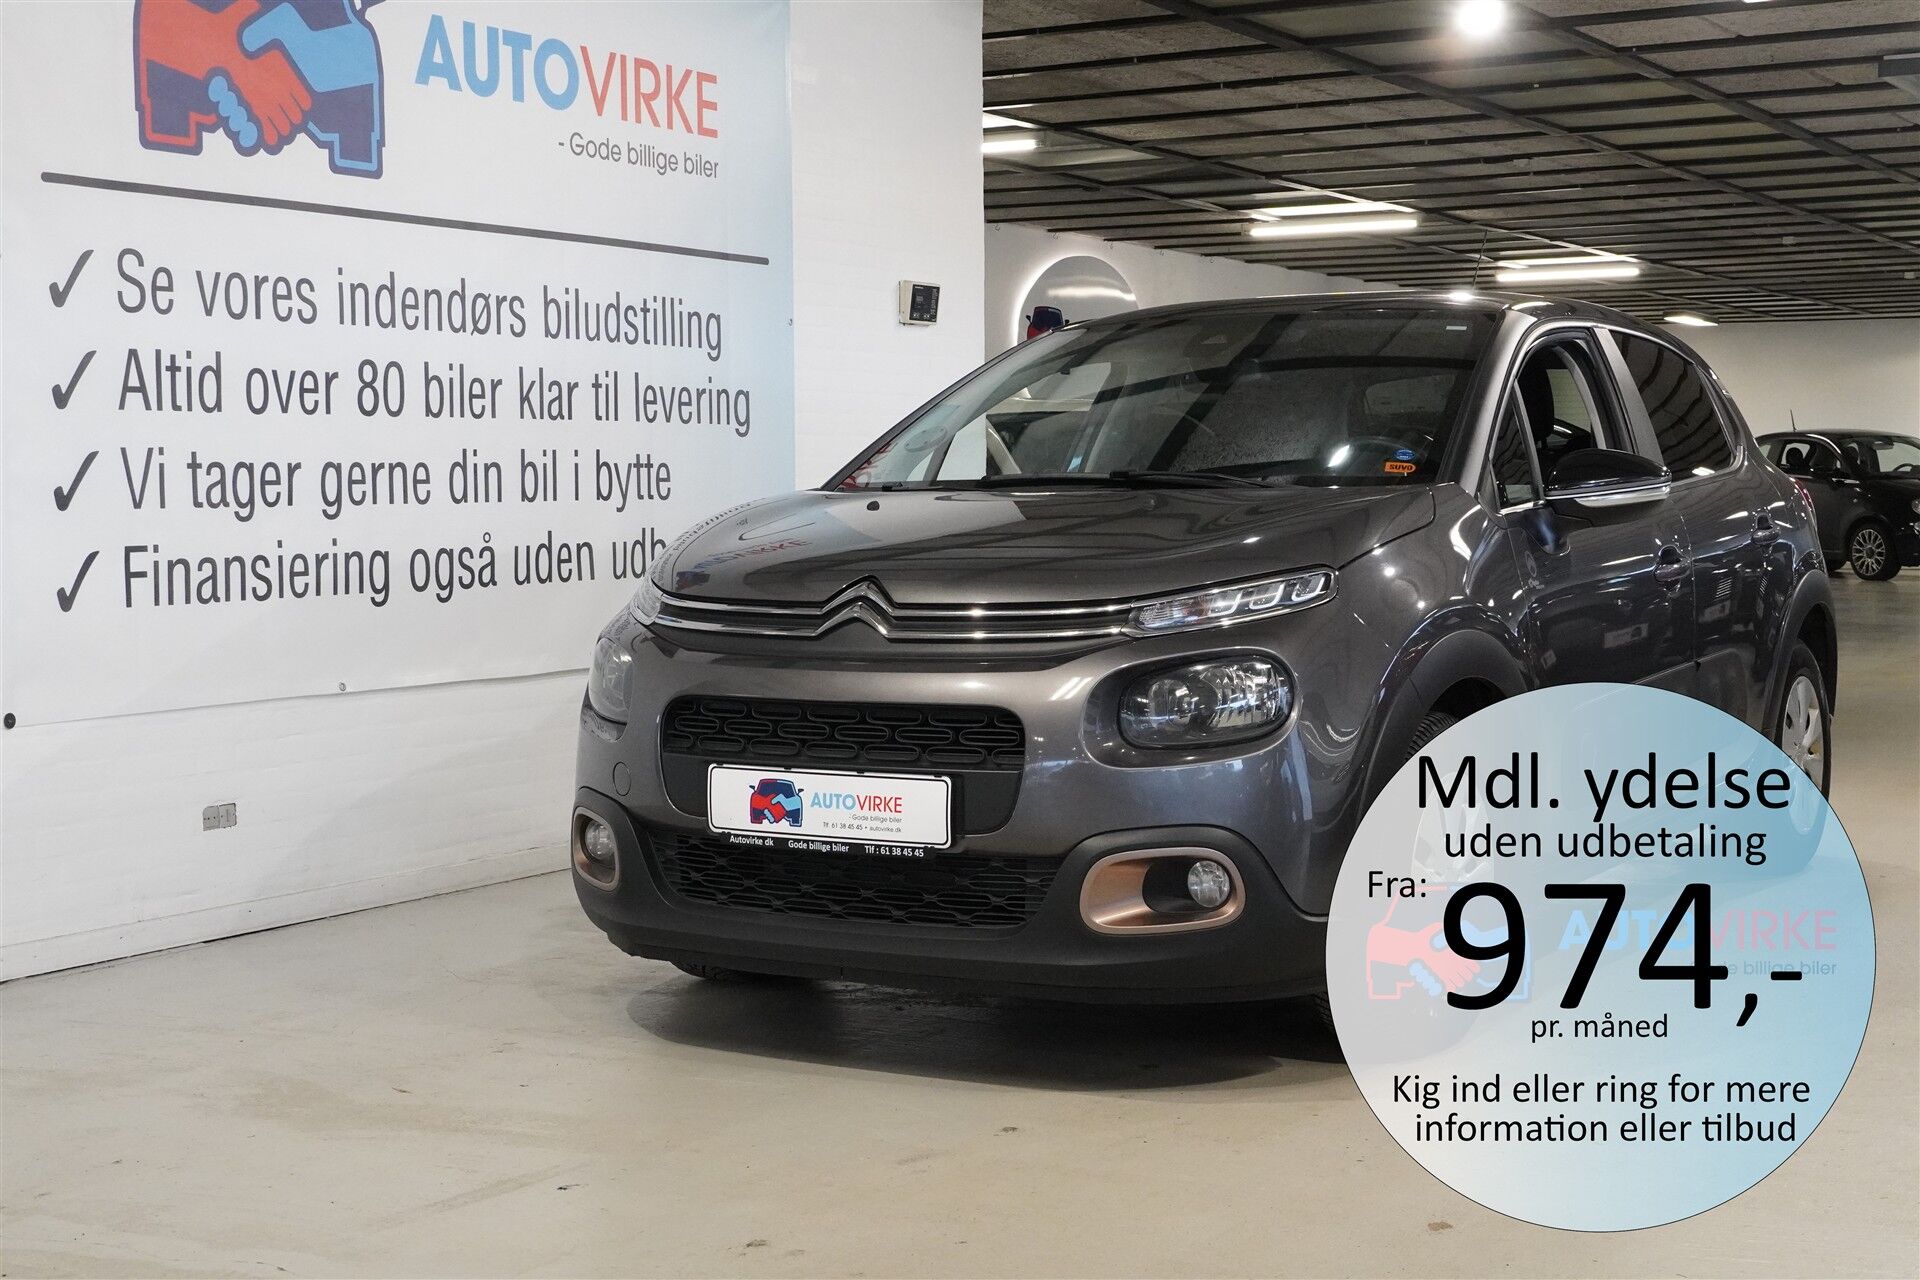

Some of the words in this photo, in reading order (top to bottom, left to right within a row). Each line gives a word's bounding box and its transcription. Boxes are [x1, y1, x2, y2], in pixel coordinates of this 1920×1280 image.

[416, 15, 719, 138] AUTOVIRKE
[569, 132, 622, 163] Gode
[627, 142, 679, 176] billige
[683, 152, 719, 179] biler
[117, 248, 174, 315] Se
[195, 271, 318, 324] vores
[337, 268, 526, 339] indendørs
[543, 285, 722, 362] biludstilling
[119, 348, 223, 413] Altid
[245, 368, 339, 416] over
[357, 359, 405, 418] 80
[423, 362, 503, 419] biler
[518, 366, 579, 421] klar
[591, 371, 619, 422] til
[634, 372, 751, 437] levering
[121, 447, 166, 509] Vi
[187, 452, 302, 522] tager
[320, 461, 431, 520] gerne
[448, 449, 503, 505] din
[520, 449, 558, 502] bil
[573, 450, 580, 502] i
[595, 449, 672, 513] bytte
[124, 538, 390, 608] Finansiering
[409, 531, 498, 604] også
[513, 530, 596, 586] uden
[810, 792, 903, 814] AUTOVIRKE
[852, 814, 869, 822] Gode
[870, 815, 888, 824] billige
[788, 840, 808, 850] Gode
[809, 841, 831, 853] billige
[832, 843, 850, 852] biler
[865, 845, 875, 854] Tlf
[880, 846, 890, 855] 61
[891, 847, 901, 856] 38
[902, 848, 913, 857] 45
[914, 848, 924, 858] 45
